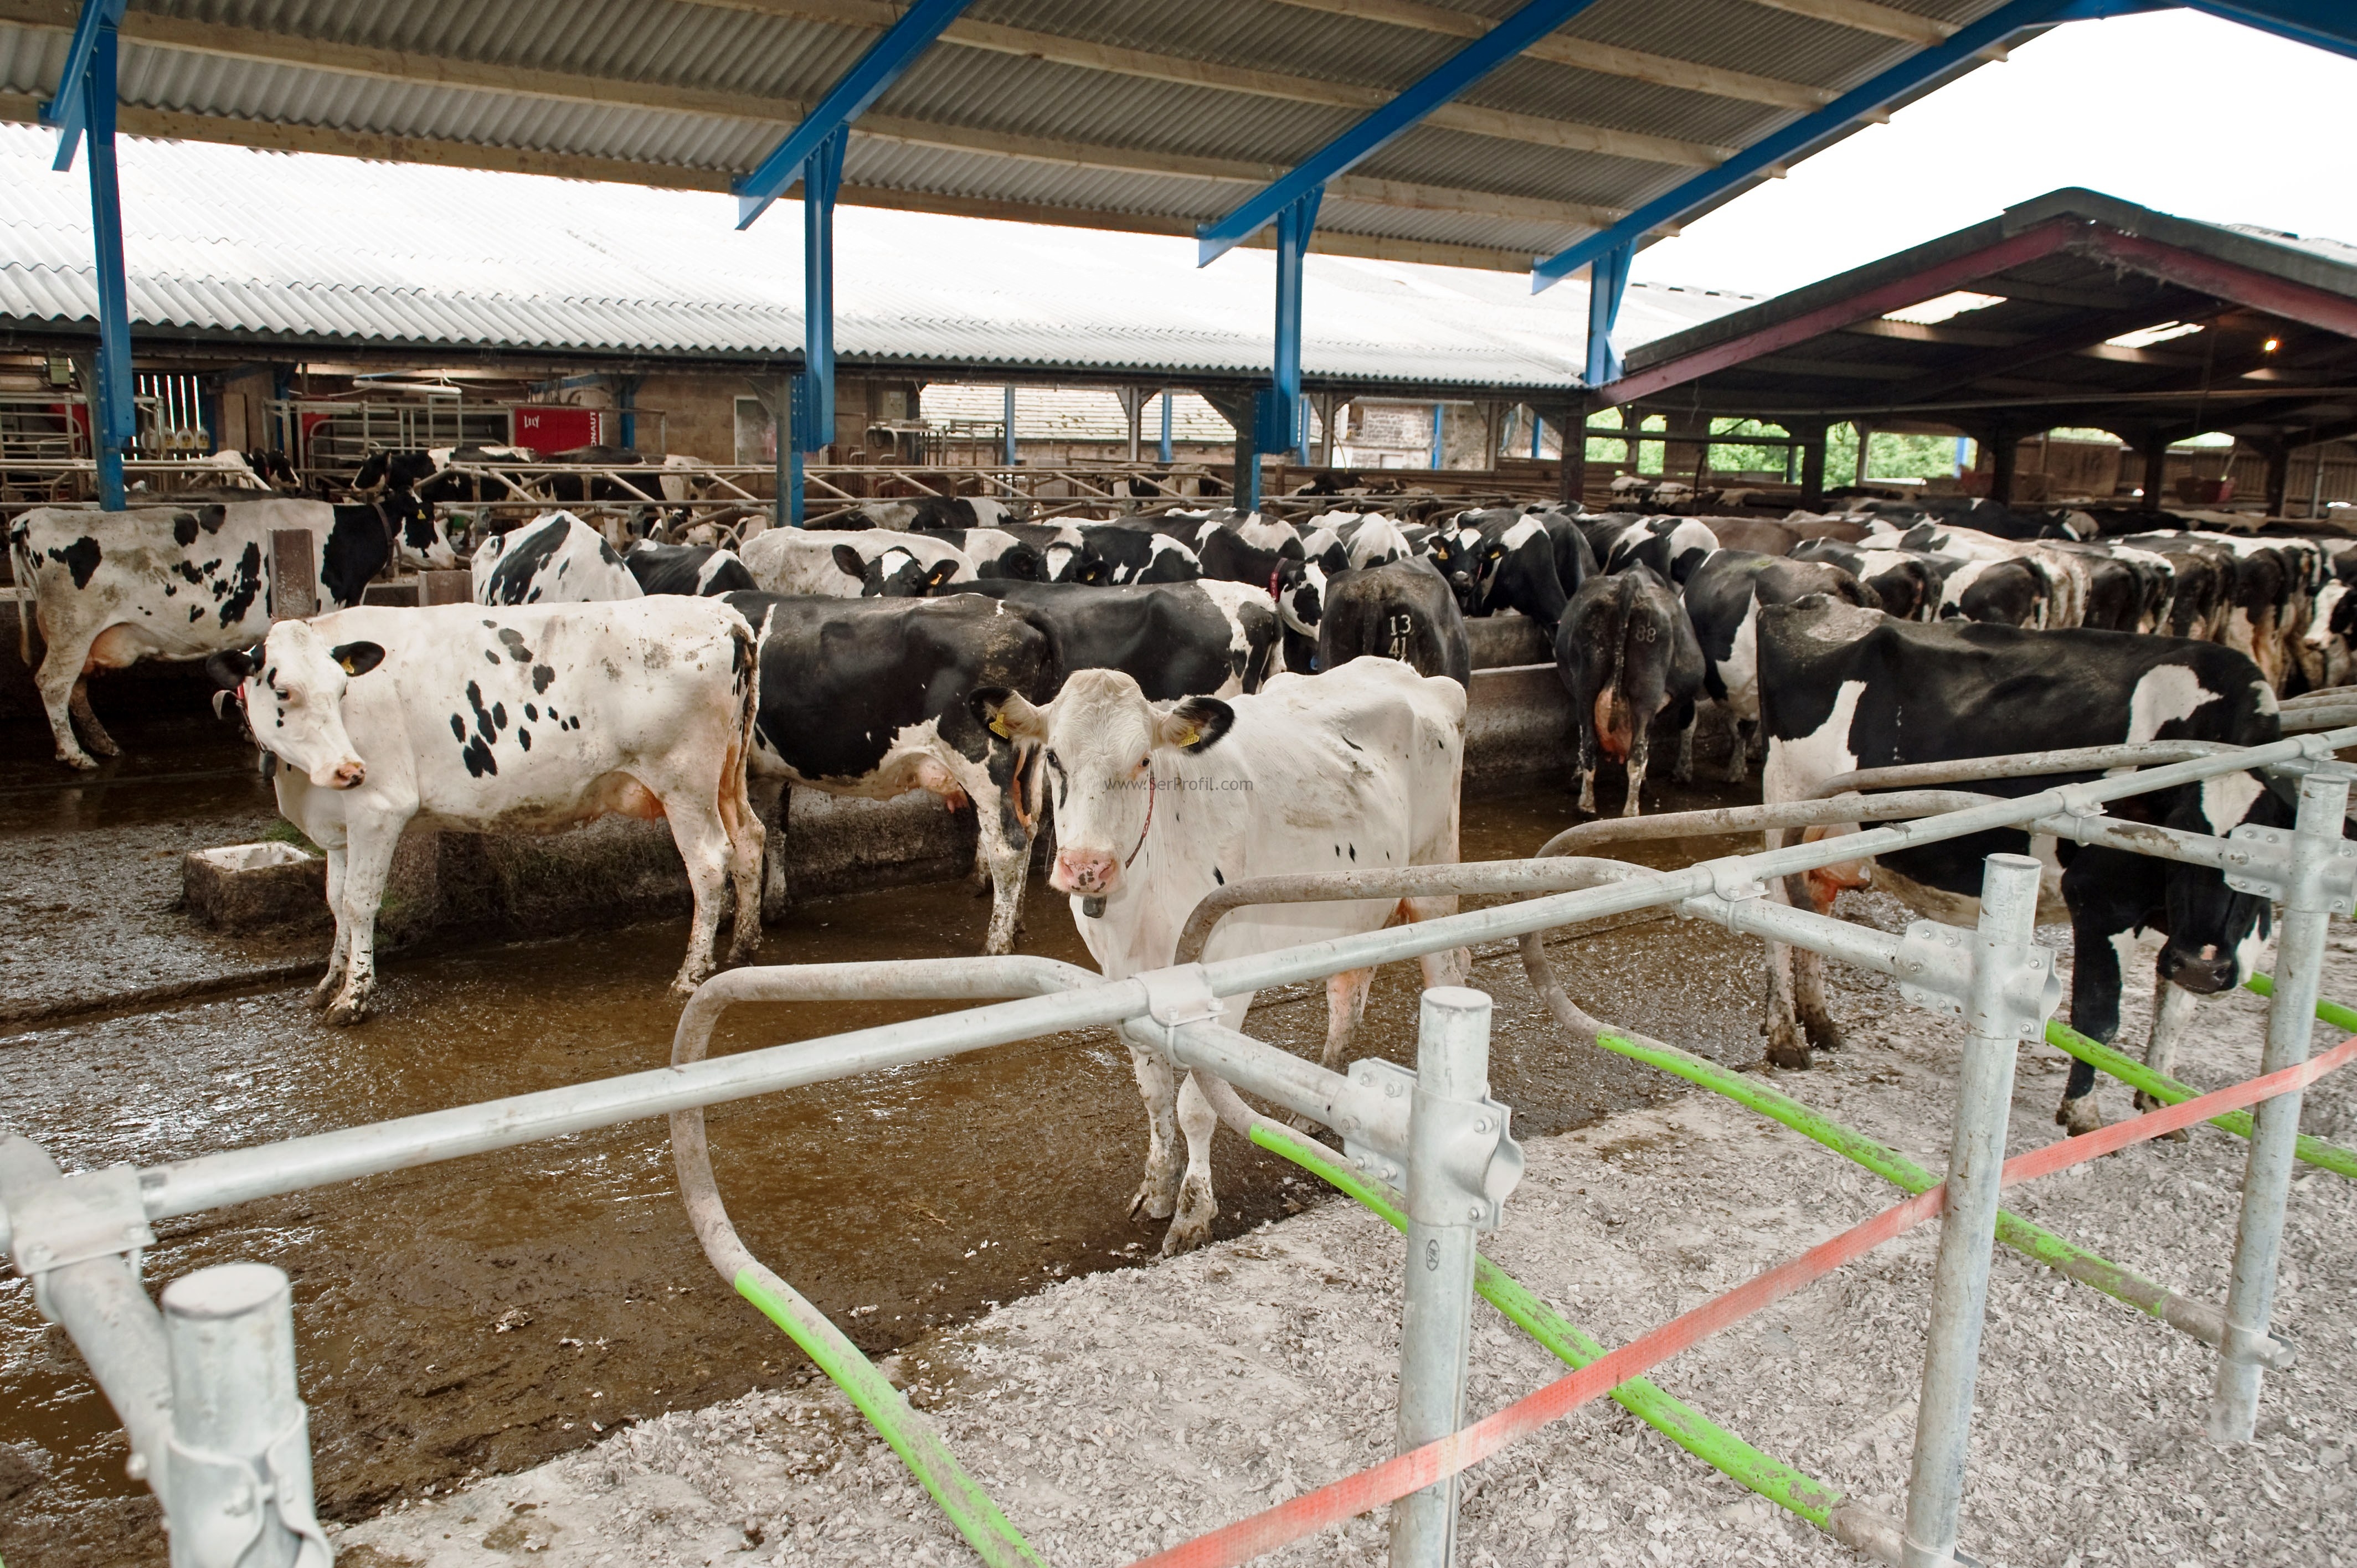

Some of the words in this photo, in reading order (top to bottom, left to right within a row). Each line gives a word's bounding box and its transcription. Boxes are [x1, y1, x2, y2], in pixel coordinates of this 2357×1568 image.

[1390, 614, 1411, 636] 13
[1636, 625, 1656, 643] 88
[1388, 637, 1407, 658] 41
